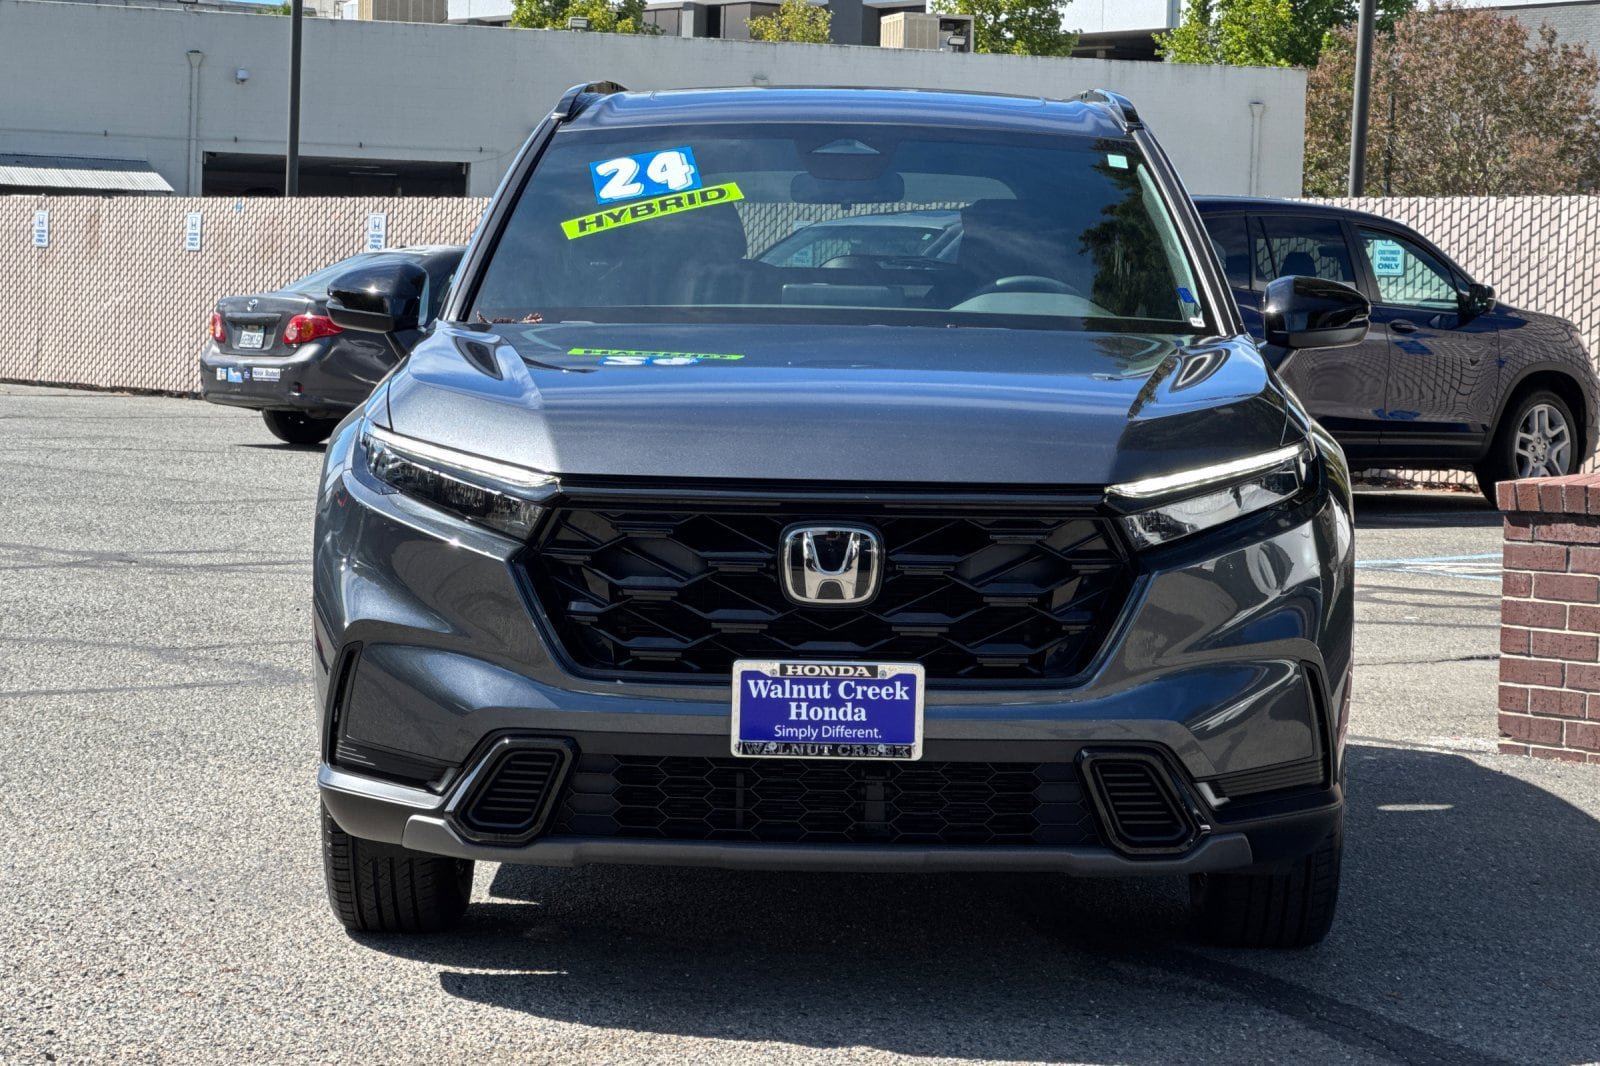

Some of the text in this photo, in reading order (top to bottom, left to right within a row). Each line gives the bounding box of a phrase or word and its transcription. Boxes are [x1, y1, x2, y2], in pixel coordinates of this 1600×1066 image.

[596, 151, 695, 199] 24
[577, 187, 729, 233] HYBRID
[785, 664, 872, 677] HONDA
[748, 679, 910, 701] Walnut Creek
[788, 702, 867, 722] Honda
[774, 724, 882, 741] Simply Different.
[744, 741, 910, 759] WALNUT CREEK
